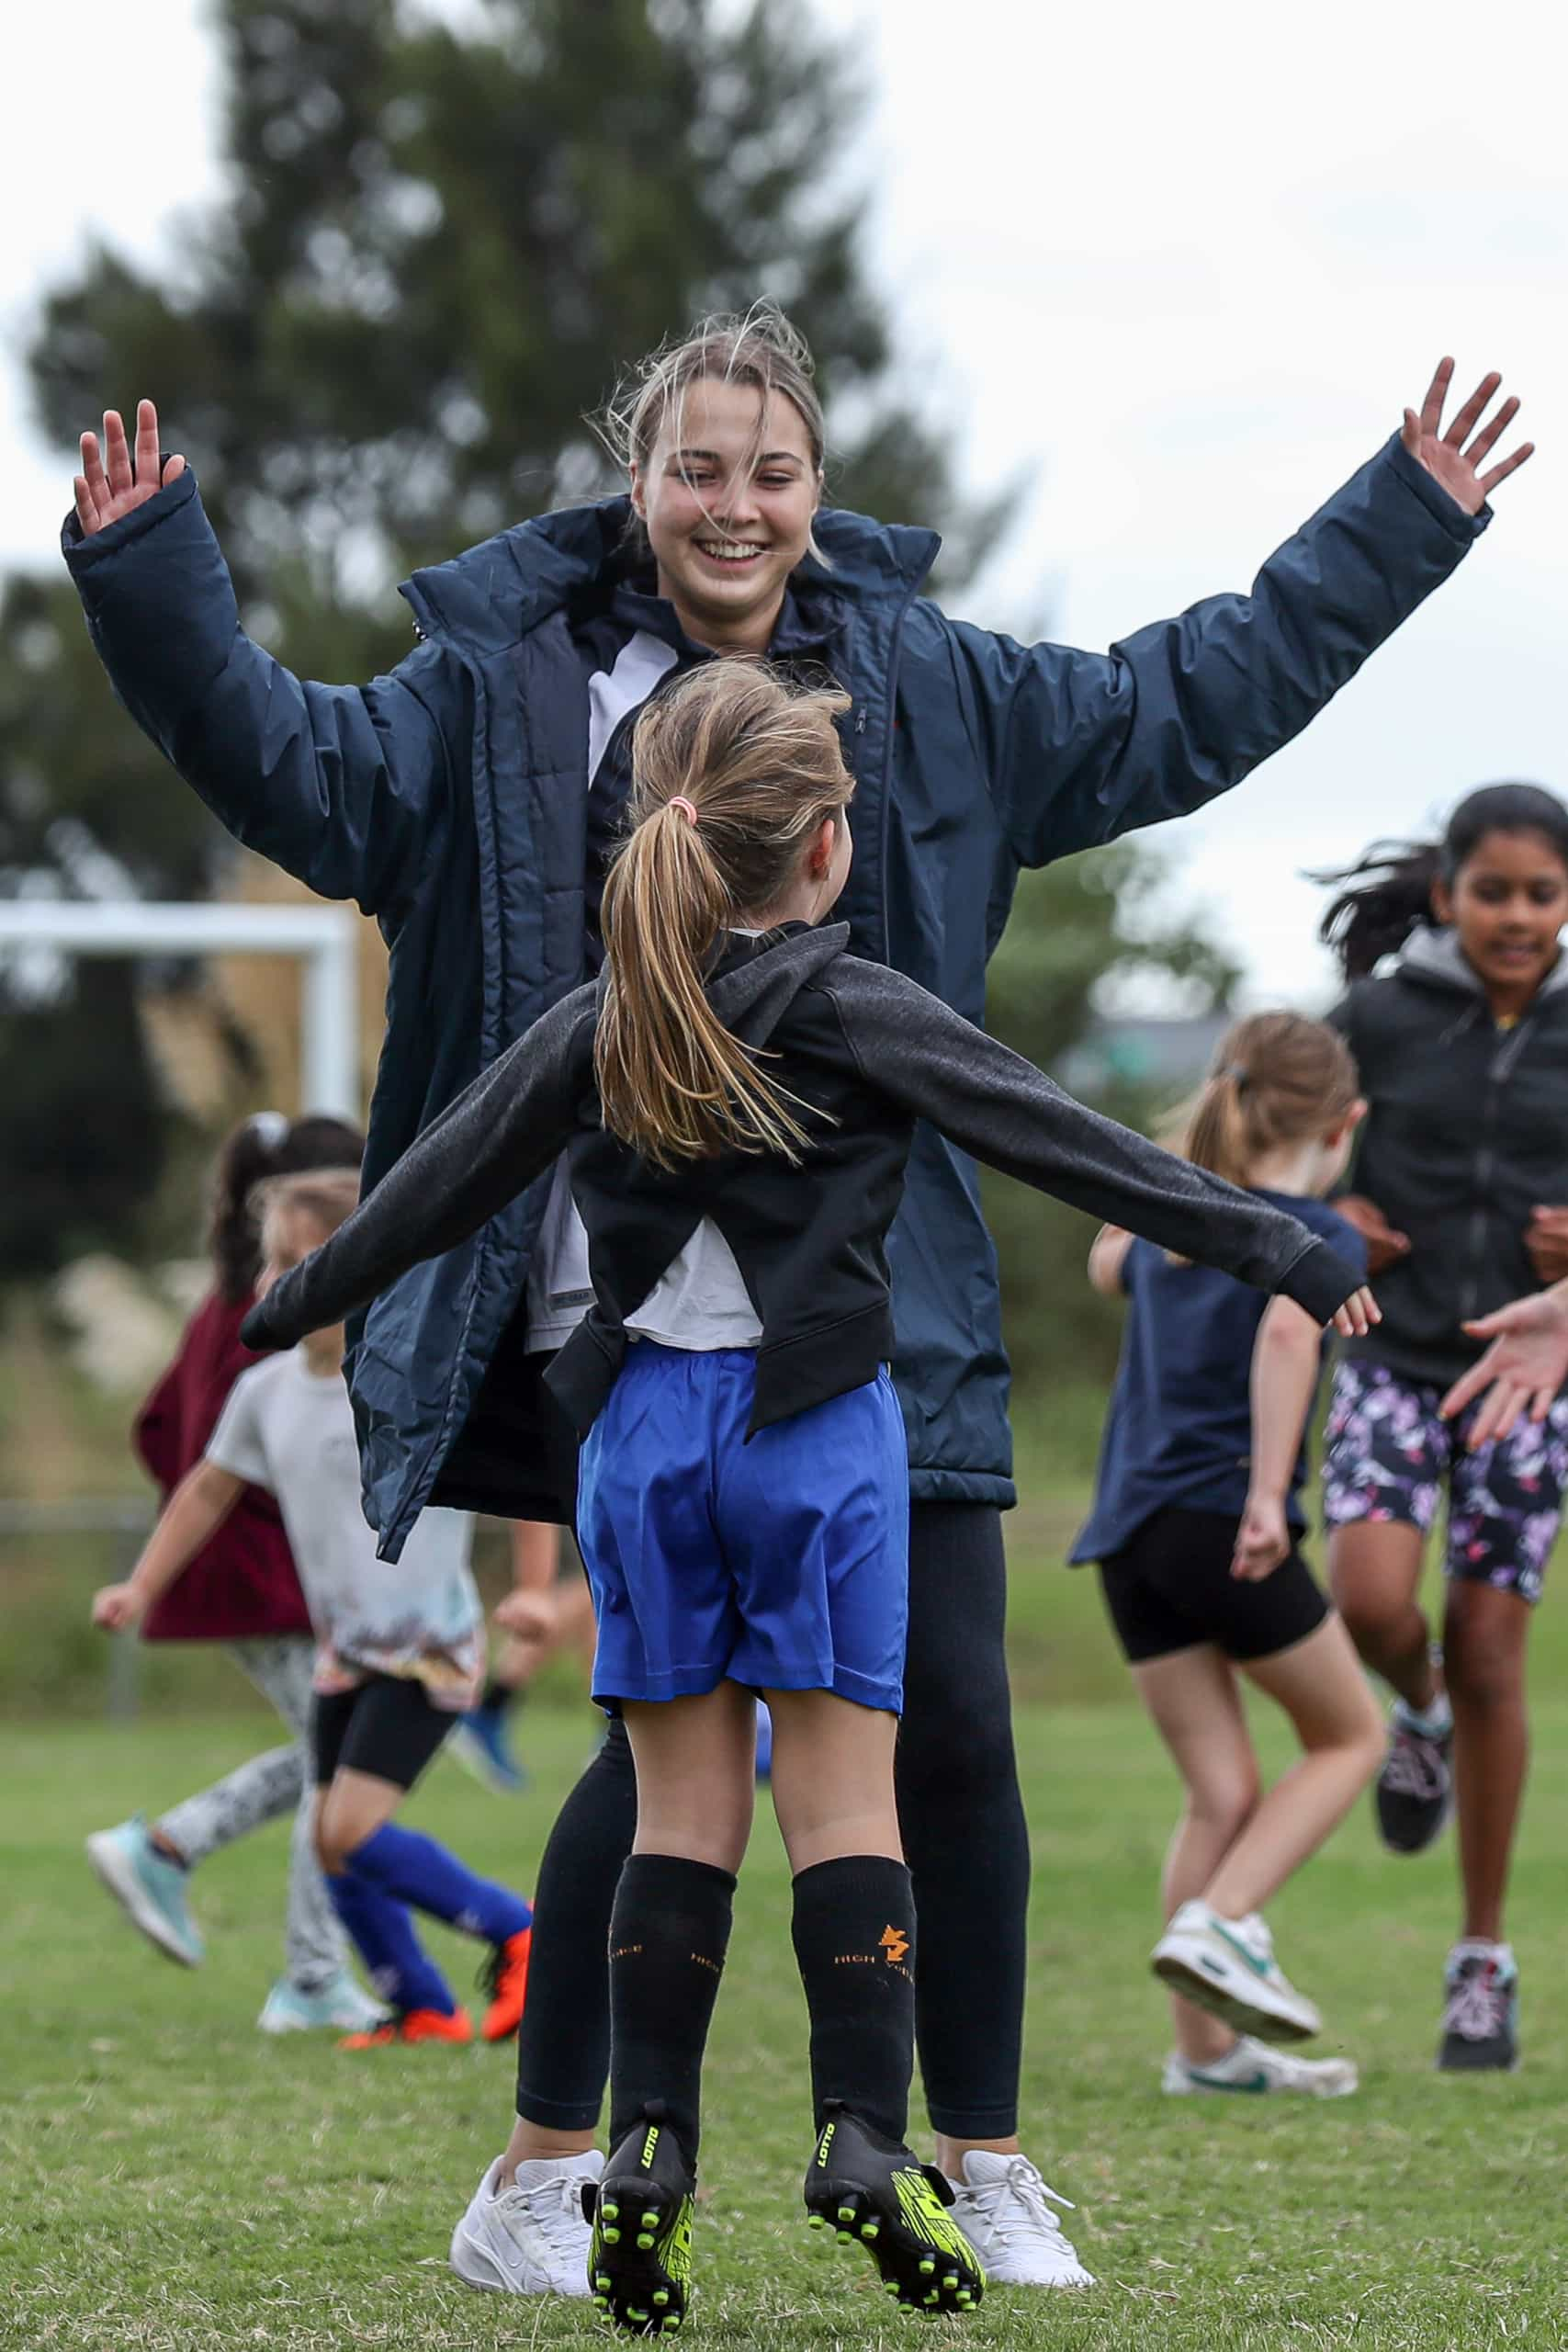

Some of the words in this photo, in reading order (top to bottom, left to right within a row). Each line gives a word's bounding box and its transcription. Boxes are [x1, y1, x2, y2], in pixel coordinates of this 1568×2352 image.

[834, 1954, 875, 1964] HIGH
[641, 2125, 659, 2168] LOTTO
[818, 2121, 835, 2167] LOTTO
